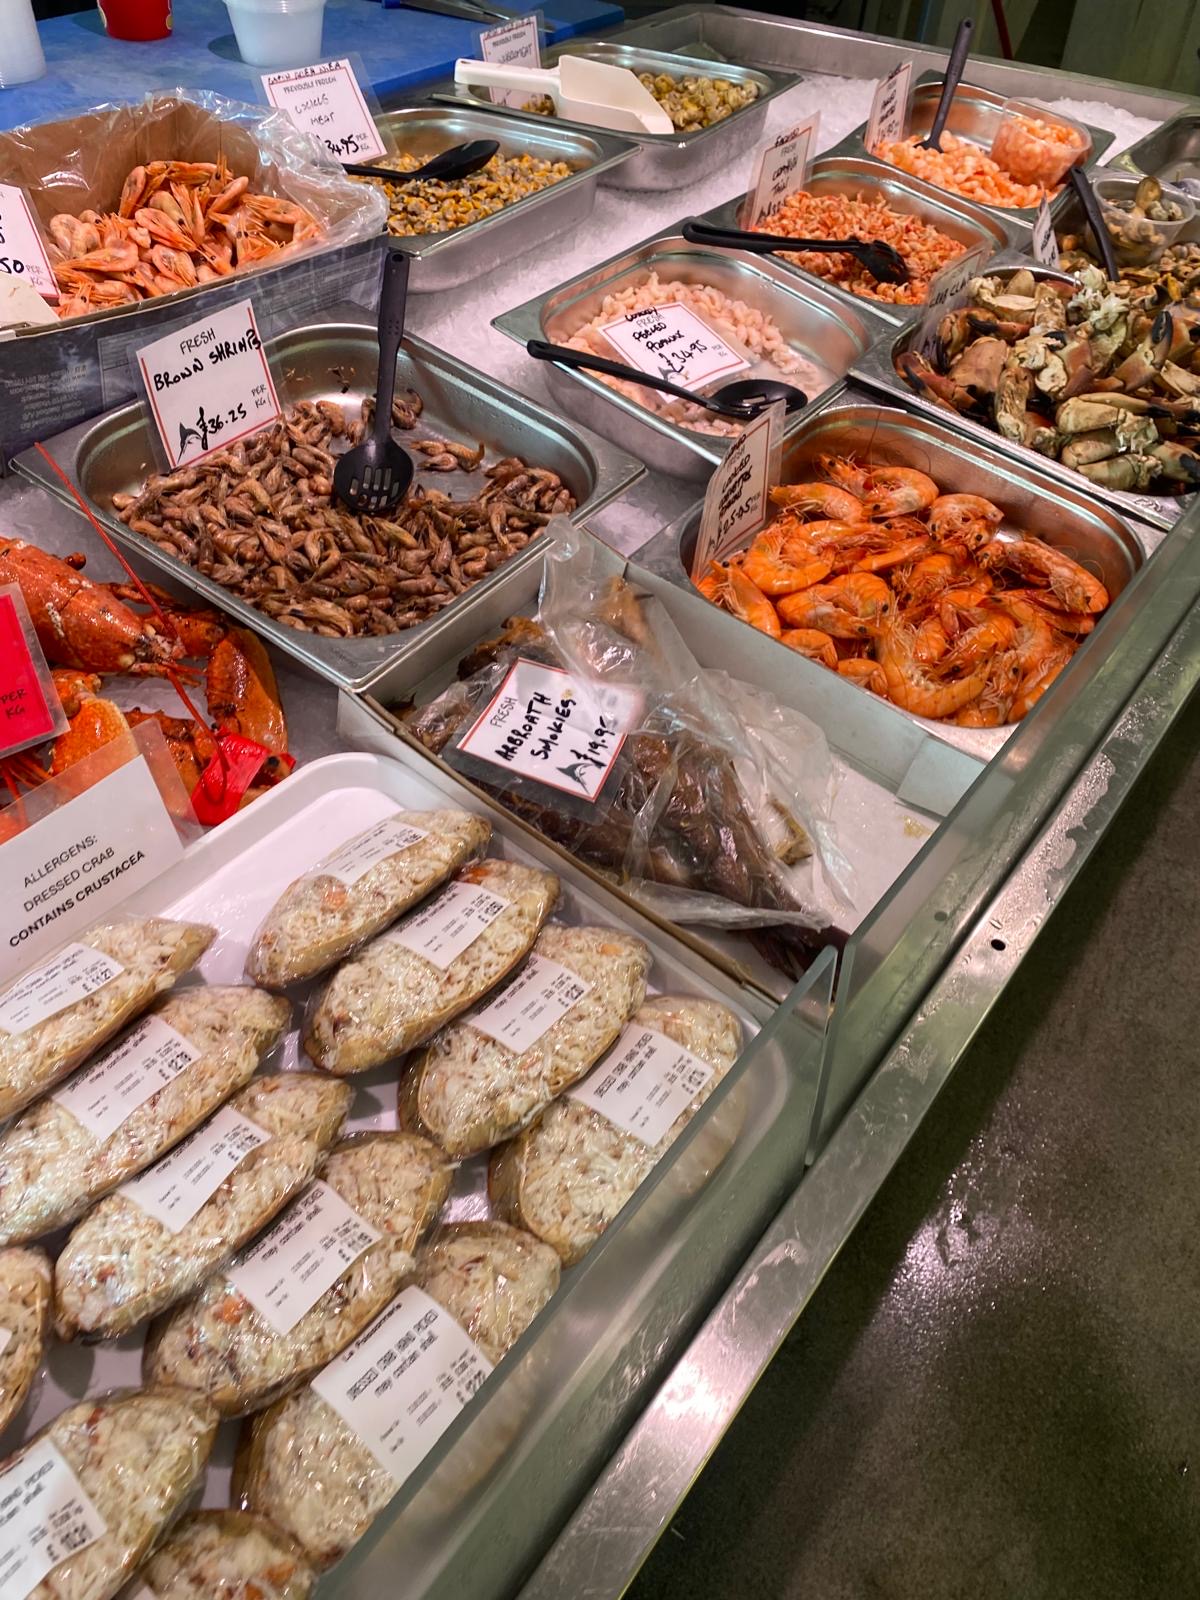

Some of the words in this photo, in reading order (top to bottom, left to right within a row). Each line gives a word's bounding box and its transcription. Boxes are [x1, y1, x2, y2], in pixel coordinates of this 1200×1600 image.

[283, 83, 314, 95] PREVIOUSLY
[316, 134, 359, 156] 34.95
[180, 327, 217, 355] FRESH
[153, 358, 204, 391] BROWN
[251, 384, 267, 397] PER
[196, 403, 247, 451] £36.25
[490, 696, 518, 728] FRESH
[495, 691, 552, 761] ARBROATH
[530, 698, 577, 760] SMOKIES
[24, 834, 98, 868] ALLERGENS:
[23, 869, 81, 912] DRESSED
[82, 847, 115, 874] CRAB
[9, 898, 75, 947] CONTAINS
[75, 850, 145, 902] CRUSTACEA
[373, 1377, 395, 1399] may
[390, 1350, 422, 1380] contain
